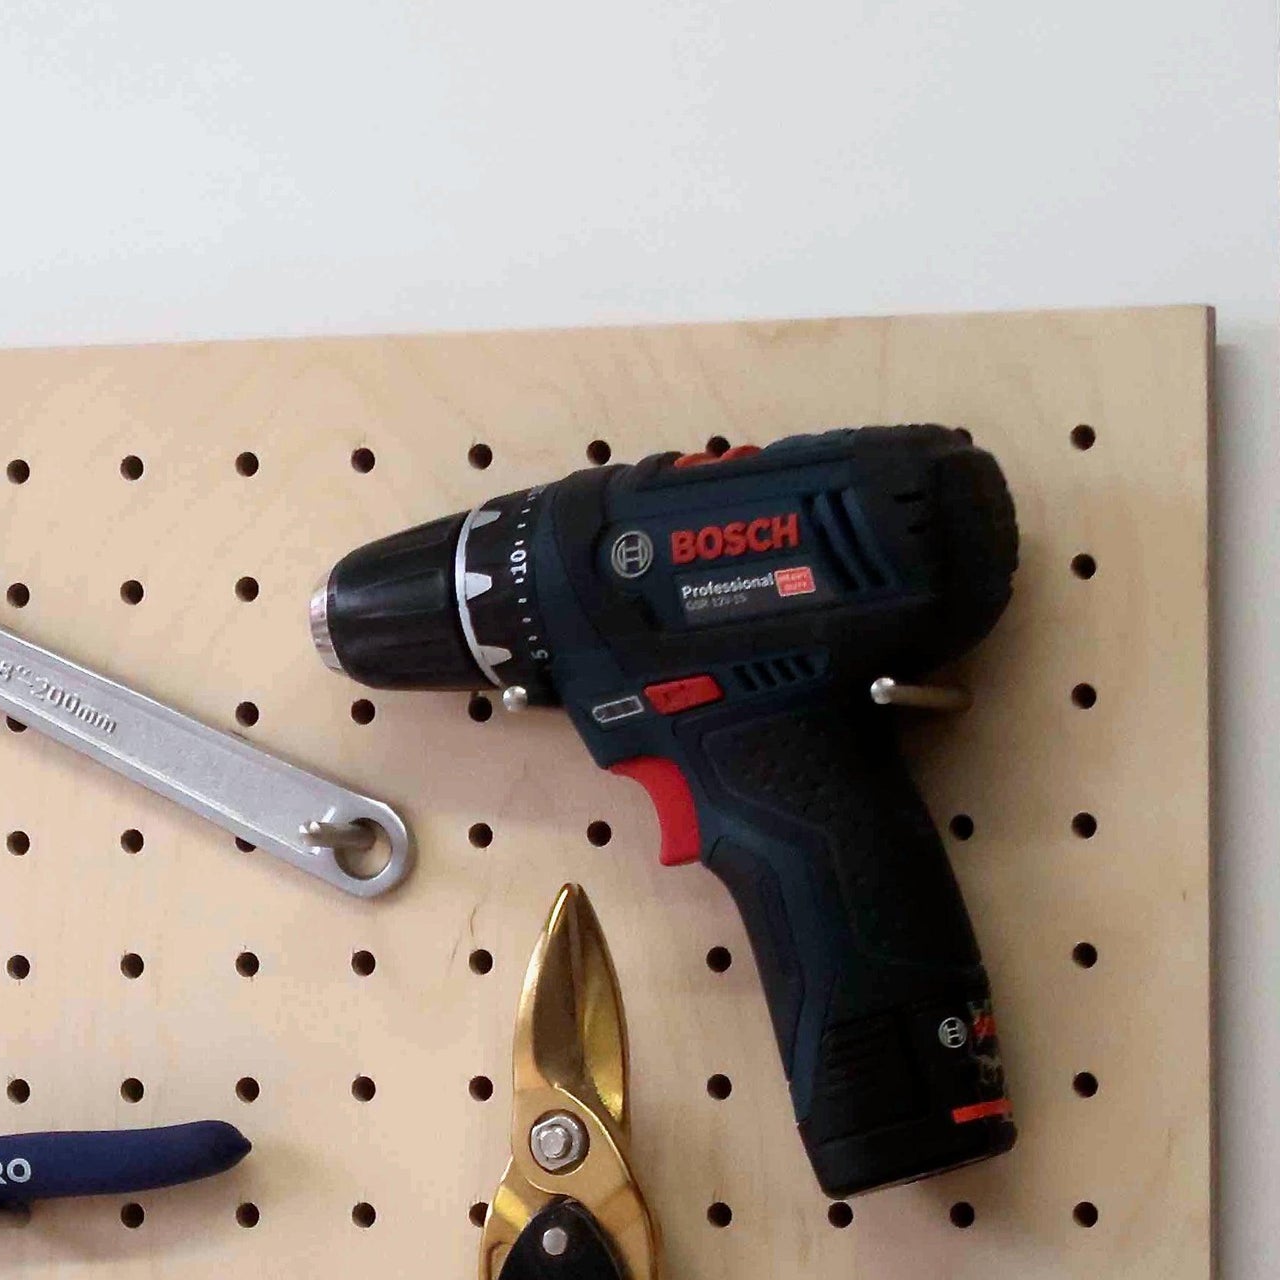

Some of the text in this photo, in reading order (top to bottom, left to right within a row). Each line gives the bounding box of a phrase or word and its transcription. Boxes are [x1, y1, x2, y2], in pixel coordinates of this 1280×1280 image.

[671, 511, 800, 565] BOSCH
[510, 549, 527, 575] 10
[680, 571, 775, 599] Professional
